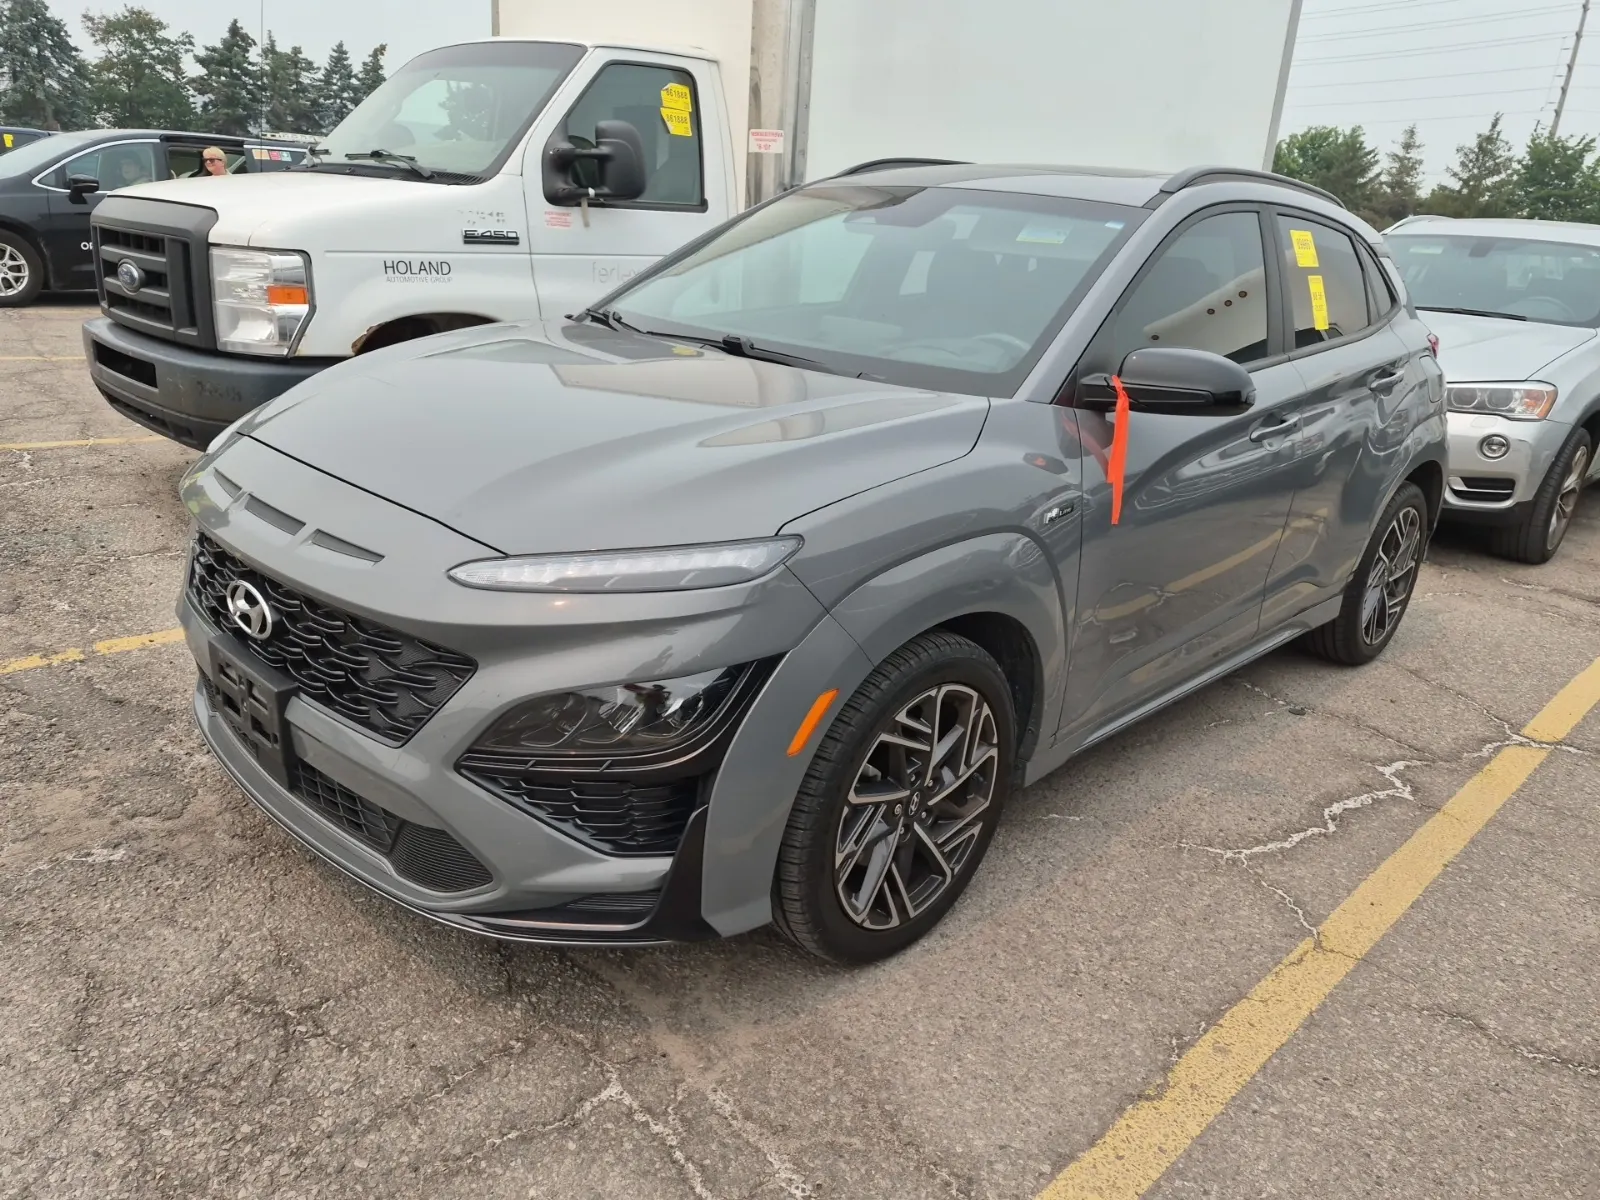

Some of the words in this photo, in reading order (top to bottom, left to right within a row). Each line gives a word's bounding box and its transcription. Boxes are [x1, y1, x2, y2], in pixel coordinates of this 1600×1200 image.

[383, 260, 452, 276] HOLAND
[386, 276, 429, 284] AUTOMOTIVE
[430, 277, 453, 285] GROUP
